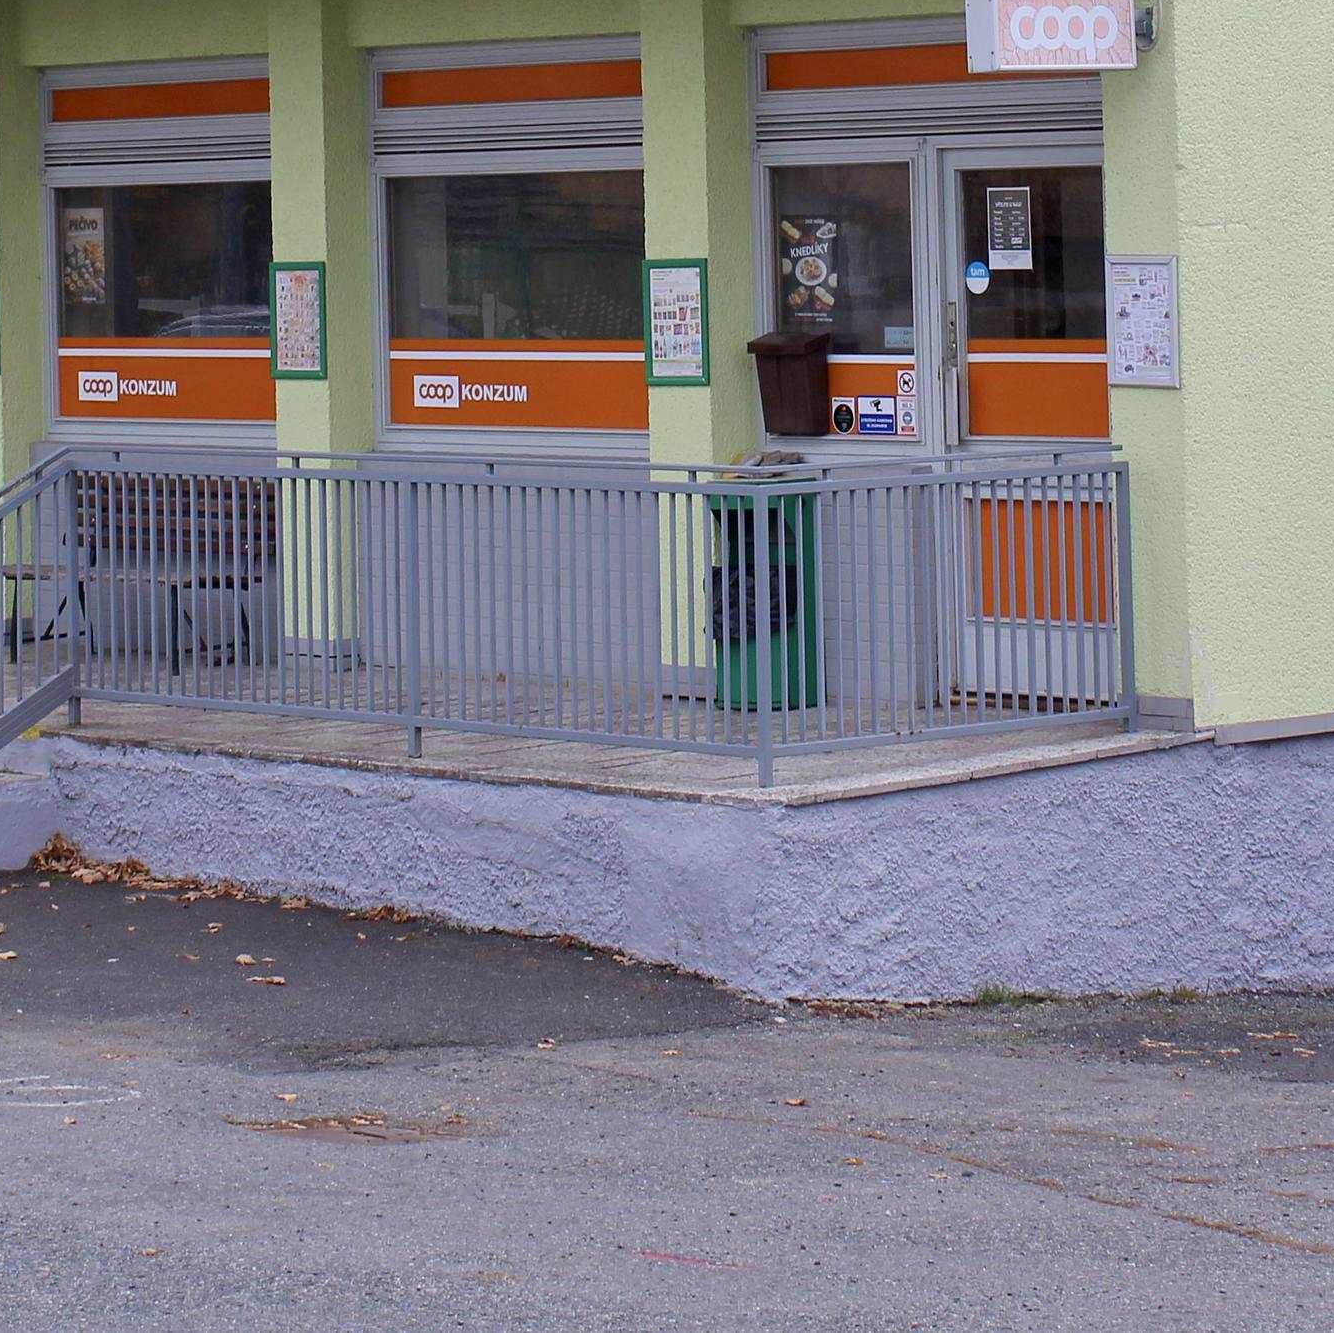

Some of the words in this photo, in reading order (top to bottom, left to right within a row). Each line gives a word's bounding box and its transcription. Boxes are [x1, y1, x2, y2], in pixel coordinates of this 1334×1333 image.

[1010, 5, 1118, 60] coop
[69, 216, 98, 231] PEČIVO
[790, 242, 829, 258] KNEDLÍKY
[83, 379, 113, 397] coop
[119, 379, 177, 396] KONZUM
[419, 383, 454, 403] coop
[461, 384, 527, 402] KONZUM
